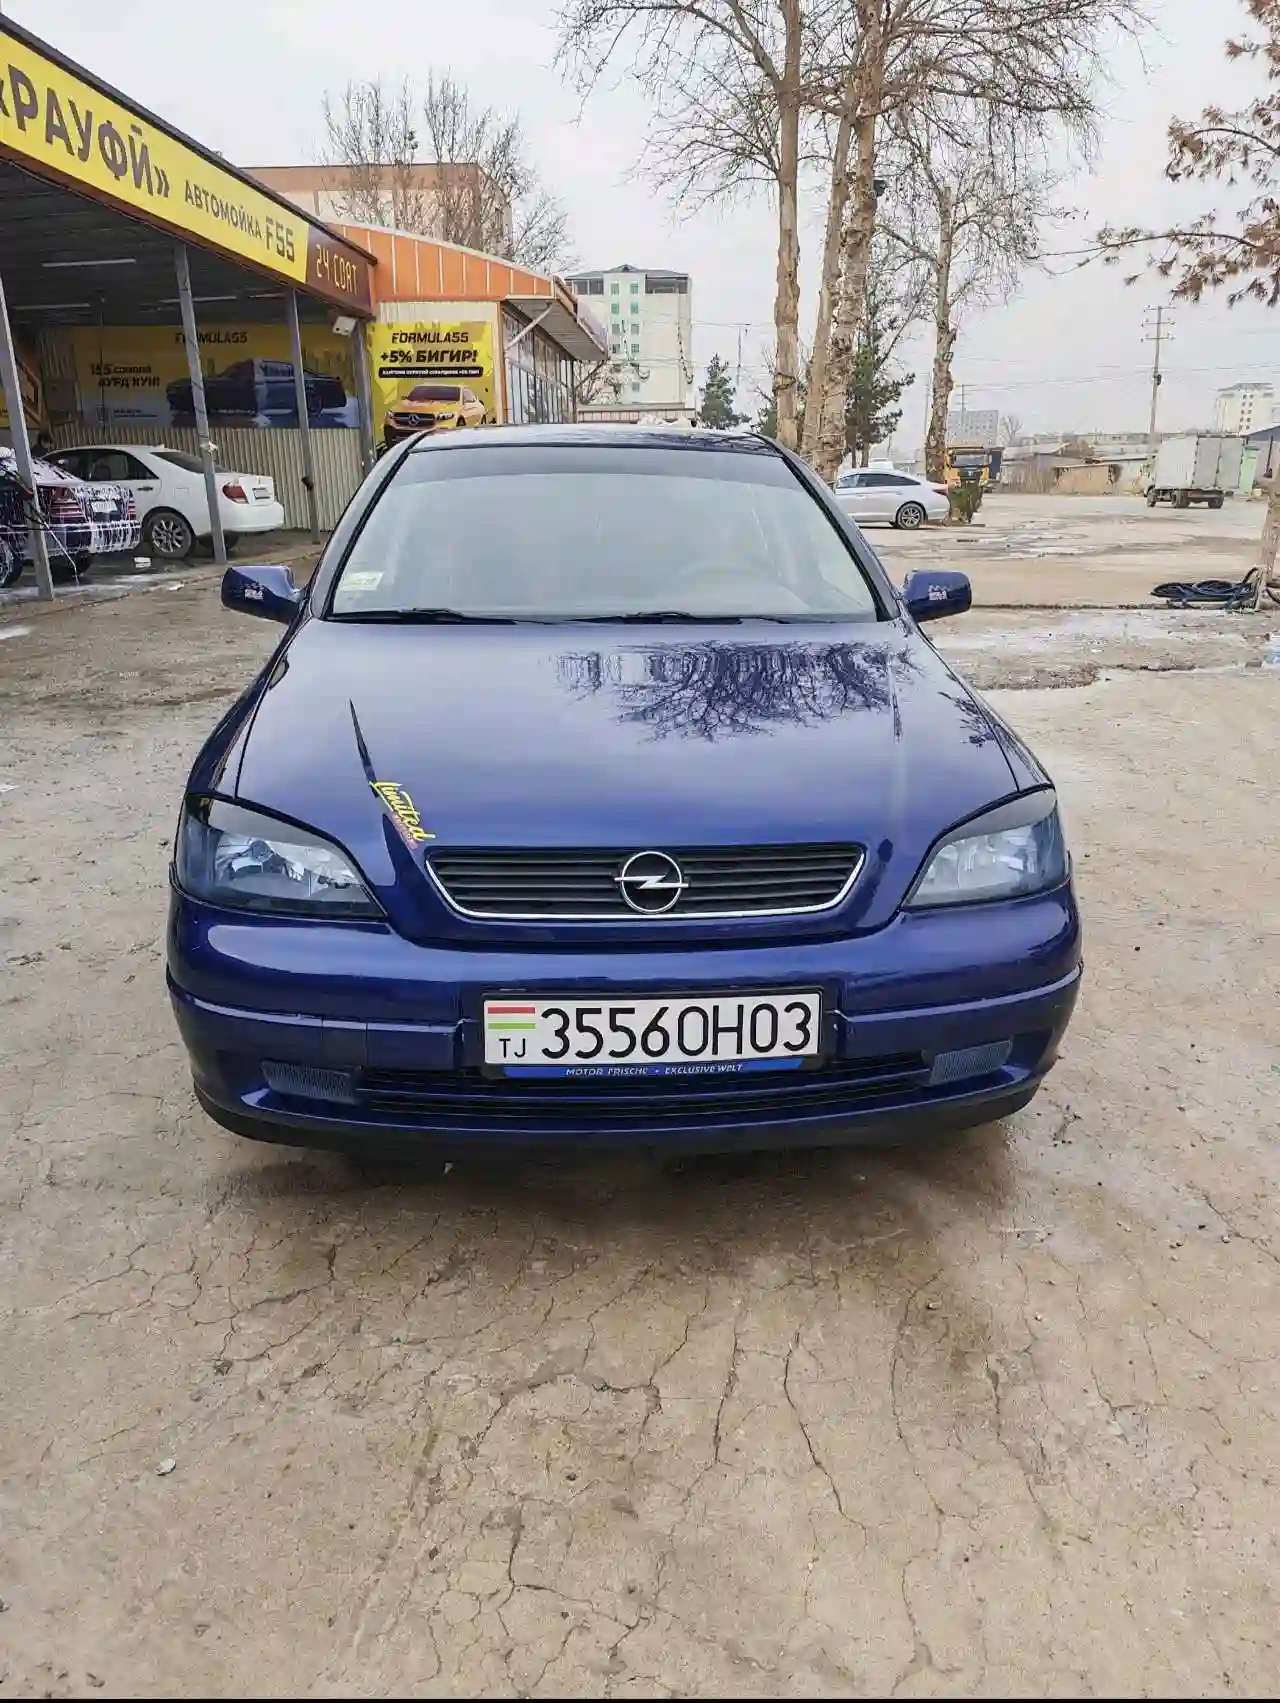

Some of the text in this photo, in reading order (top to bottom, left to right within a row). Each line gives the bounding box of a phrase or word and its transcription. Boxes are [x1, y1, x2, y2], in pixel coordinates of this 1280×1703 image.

[184, 180, 262, 240] АВТОМОЙКА
[265, 215, 295, 263] F55
[316, 244, 358, 296] 24 СОАТ
[391, 331, 469, 344] FORMULA55
[380, 349, 478, 363] +5% БИГИР!
[498, 1037, 527, 1059] TJ
[565, 1067, 604, 1077] MOTOR
[664, 1064, 716, 1075] EXCLUSIVE
